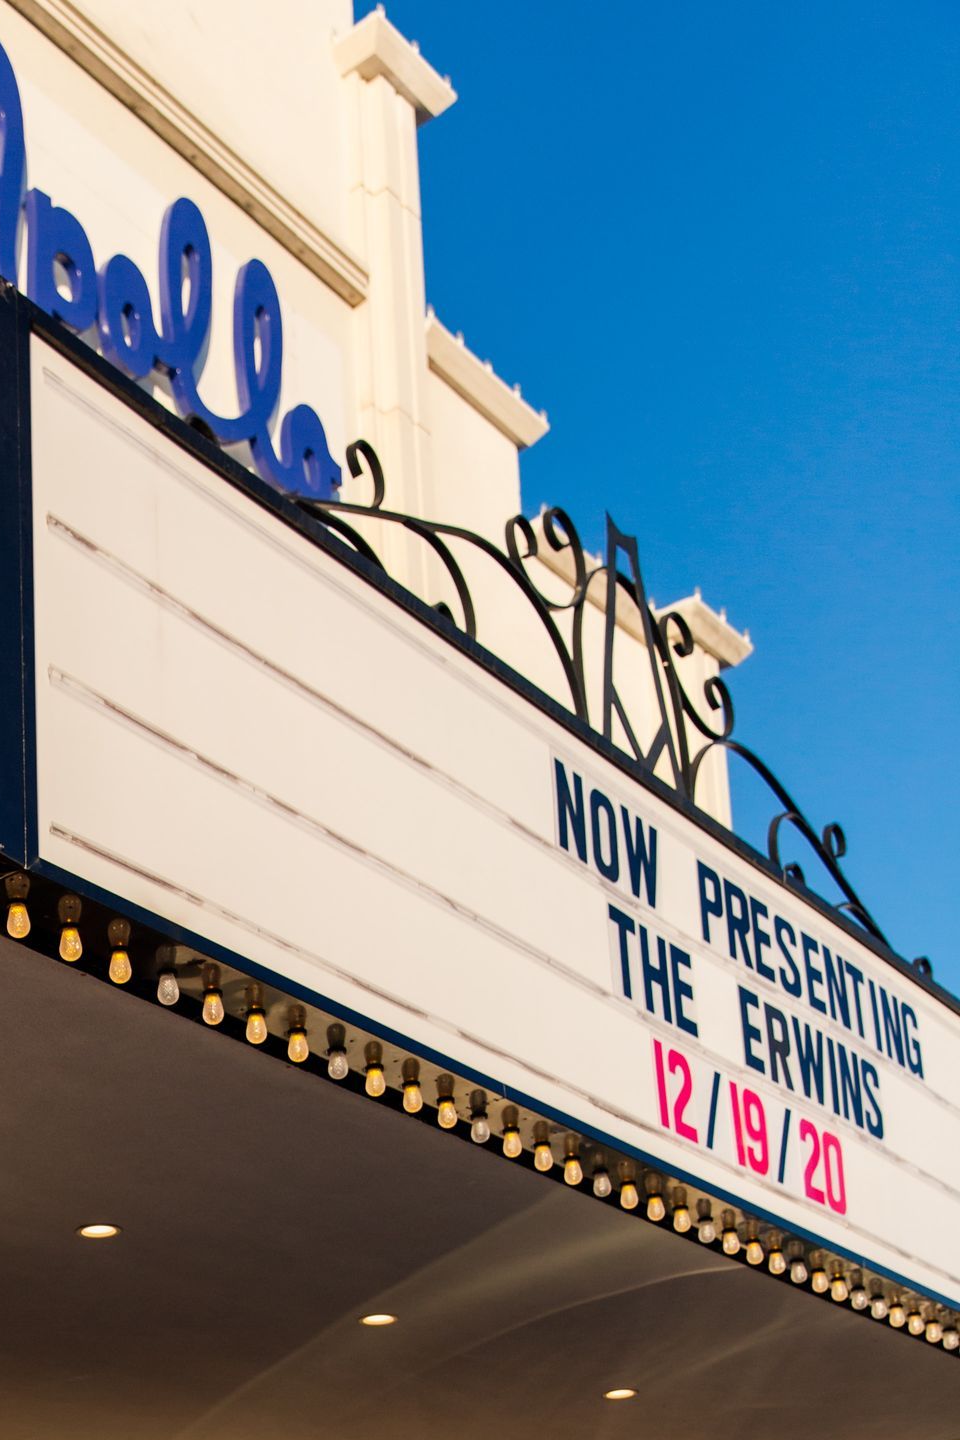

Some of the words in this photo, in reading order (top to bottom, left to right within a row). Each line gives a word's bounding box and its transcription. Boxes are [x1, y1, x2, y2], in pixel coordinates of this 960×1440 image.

[553, 757, 658, 909] NOW
[696, 858, 925, 1080] PRESENTING
[607, 903, 699, 1038] THE
[737, 984, 884, 1140] ERWINS
[653, 1038, 847, 1216] 12/19/20
